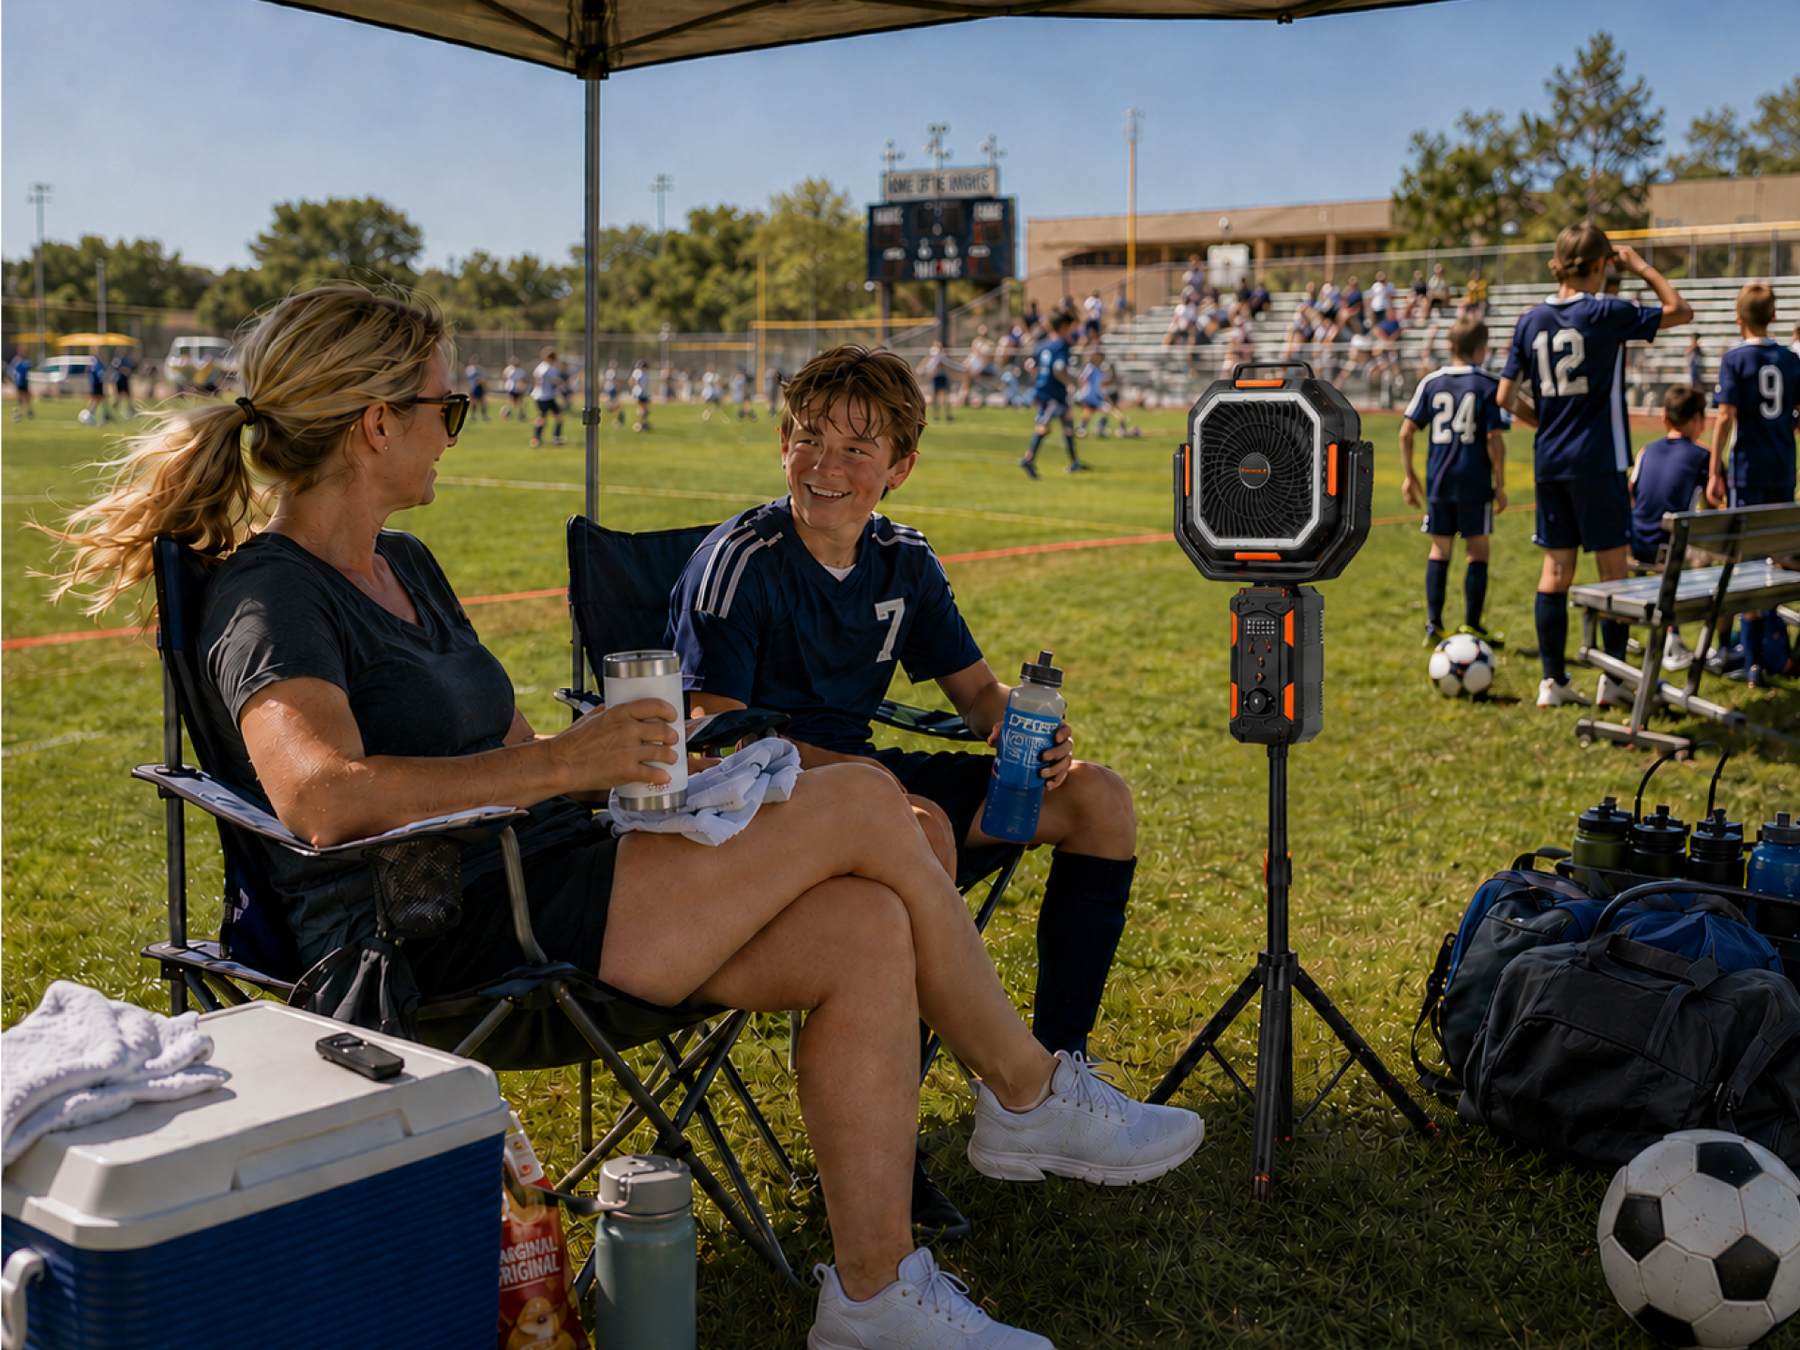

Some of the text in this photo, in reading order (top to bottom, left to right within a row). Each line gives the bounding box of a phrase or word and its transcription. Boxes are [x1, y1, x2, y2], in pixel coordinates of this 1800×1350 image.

[1532, 328, 1589, 398] 12
[1432, 392, 1476, 445] 24
[1759, 365, 1784, 419] 9
[874, 597, 906, 663] 7
[499, 1253, 561, 1288] RIGINAL
